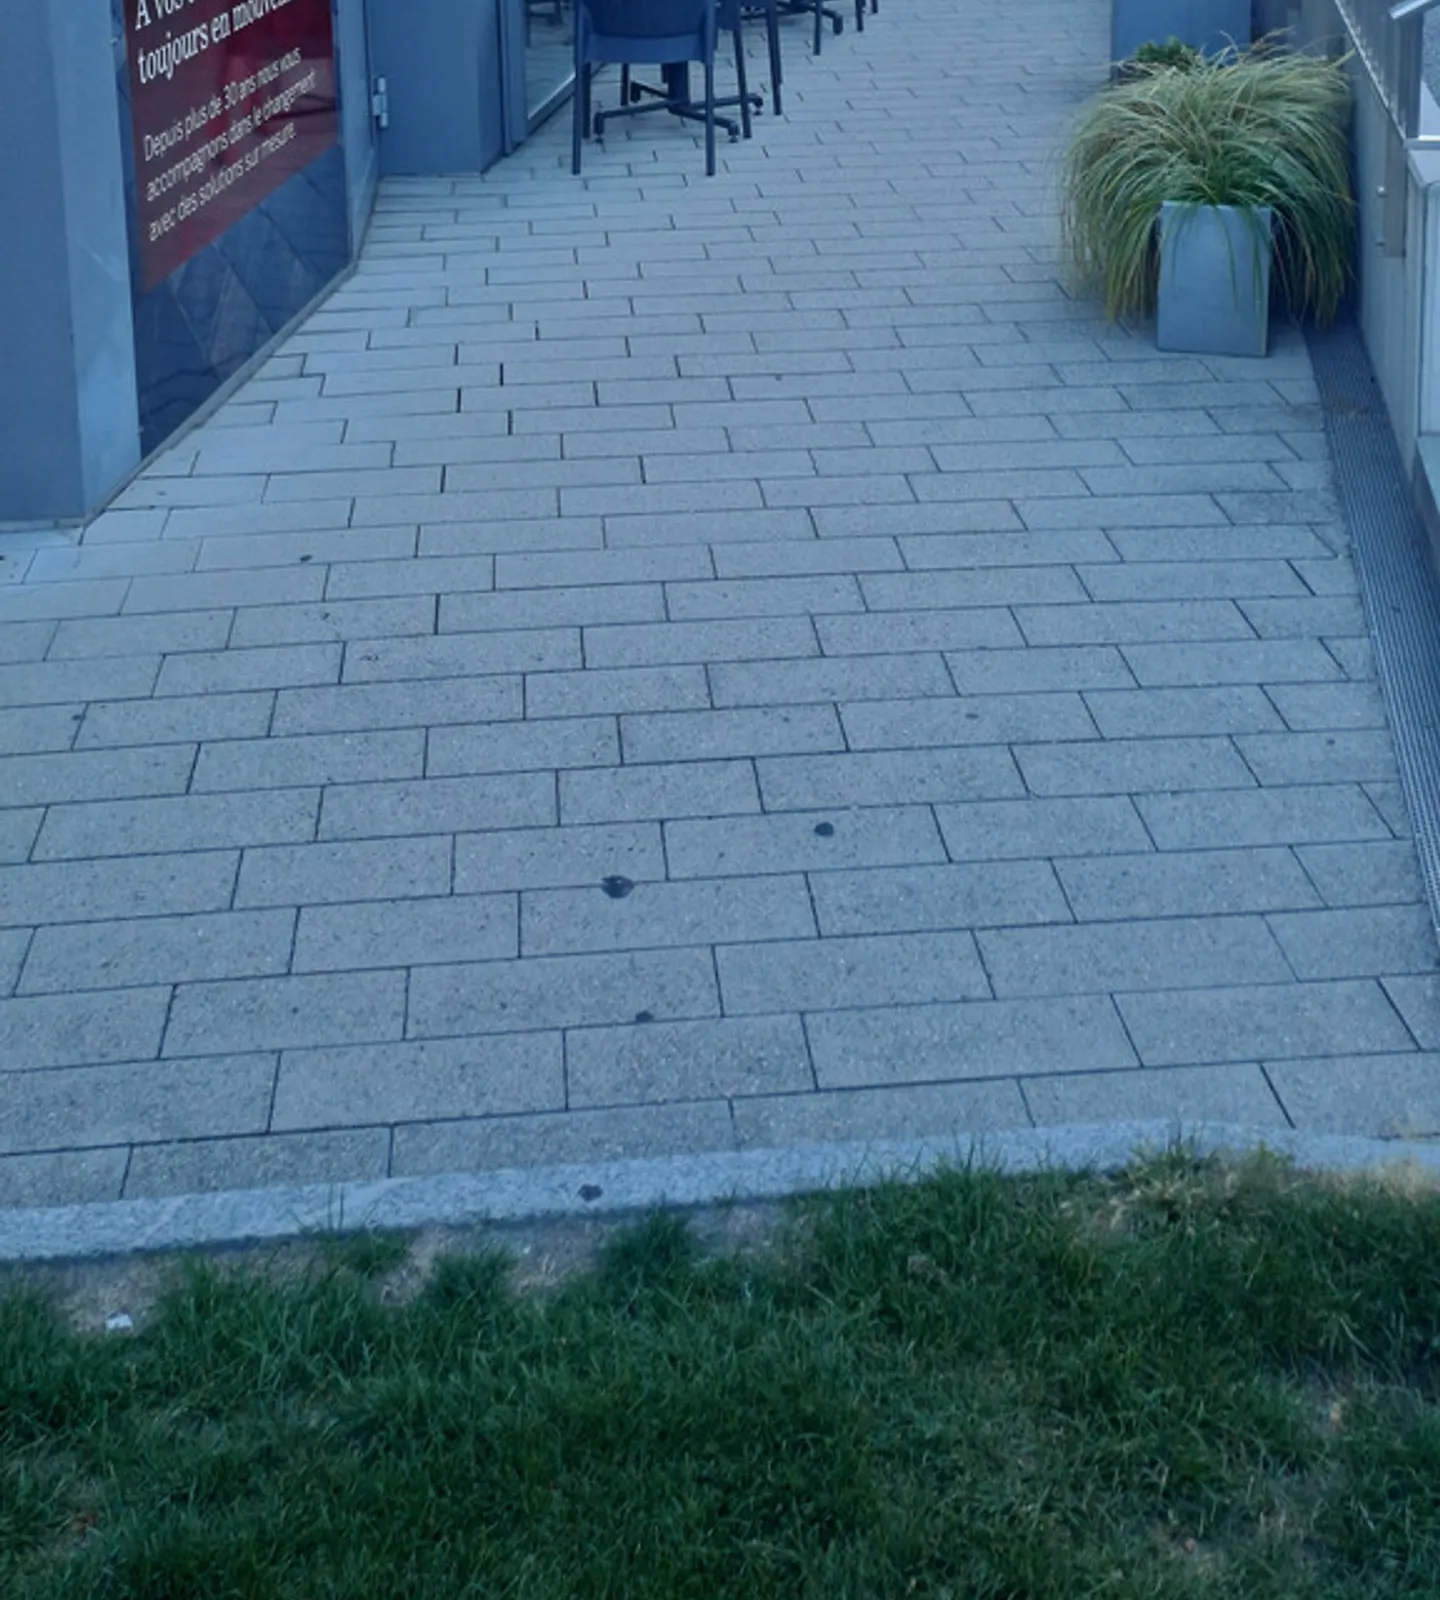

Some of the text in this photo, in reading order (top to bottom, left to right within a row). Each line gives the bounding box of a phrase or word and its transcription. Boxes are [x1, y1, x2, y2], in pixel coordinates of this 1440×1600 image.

[138, 22, 209, 85] toujours
[210, 12, 231, 43] en
[143, 47, 301, 162] Depuis plus de 30 ans nous vous
[147, 66, 316, 202] accompagnons dans le changement
[149, 207, 177, 242] avec
[177, 191, 199, 221] des
[199, 159, 243, 207] solutions
[244, 147, 259, 172] sur
